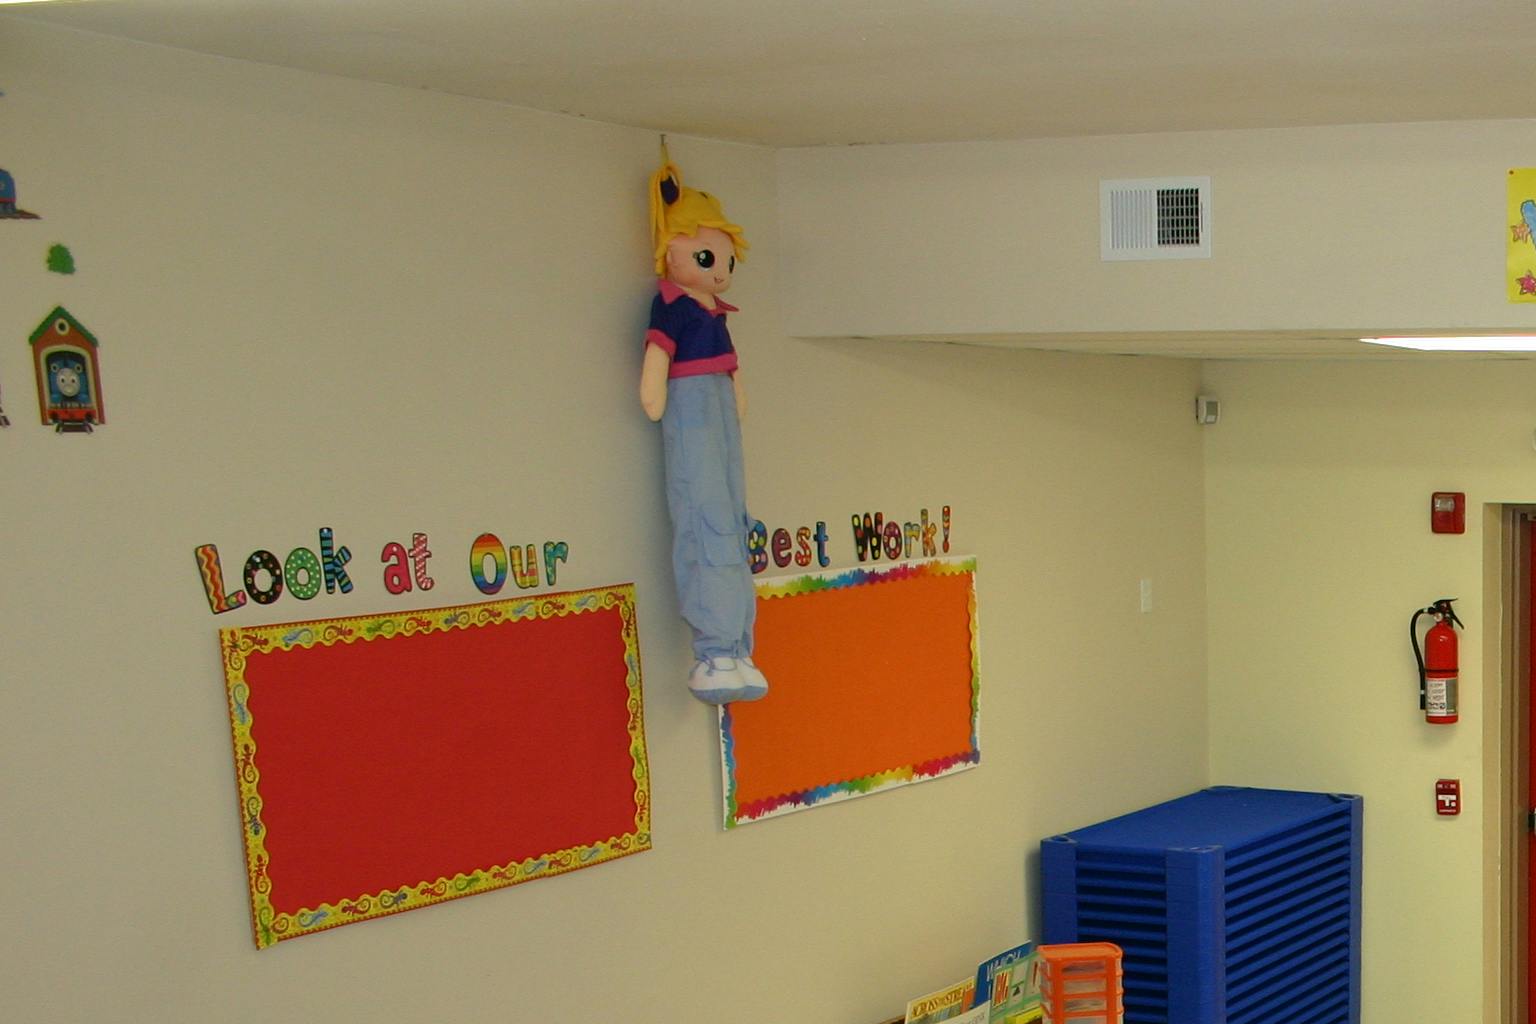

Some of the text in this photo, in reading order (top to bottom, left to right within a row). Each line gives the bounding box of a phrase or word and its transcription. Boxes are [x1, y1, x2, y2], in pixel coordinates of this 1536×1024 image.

[195, 527, 569, 614] Look at Our
[748, 505, 951, 574] Best Work!
